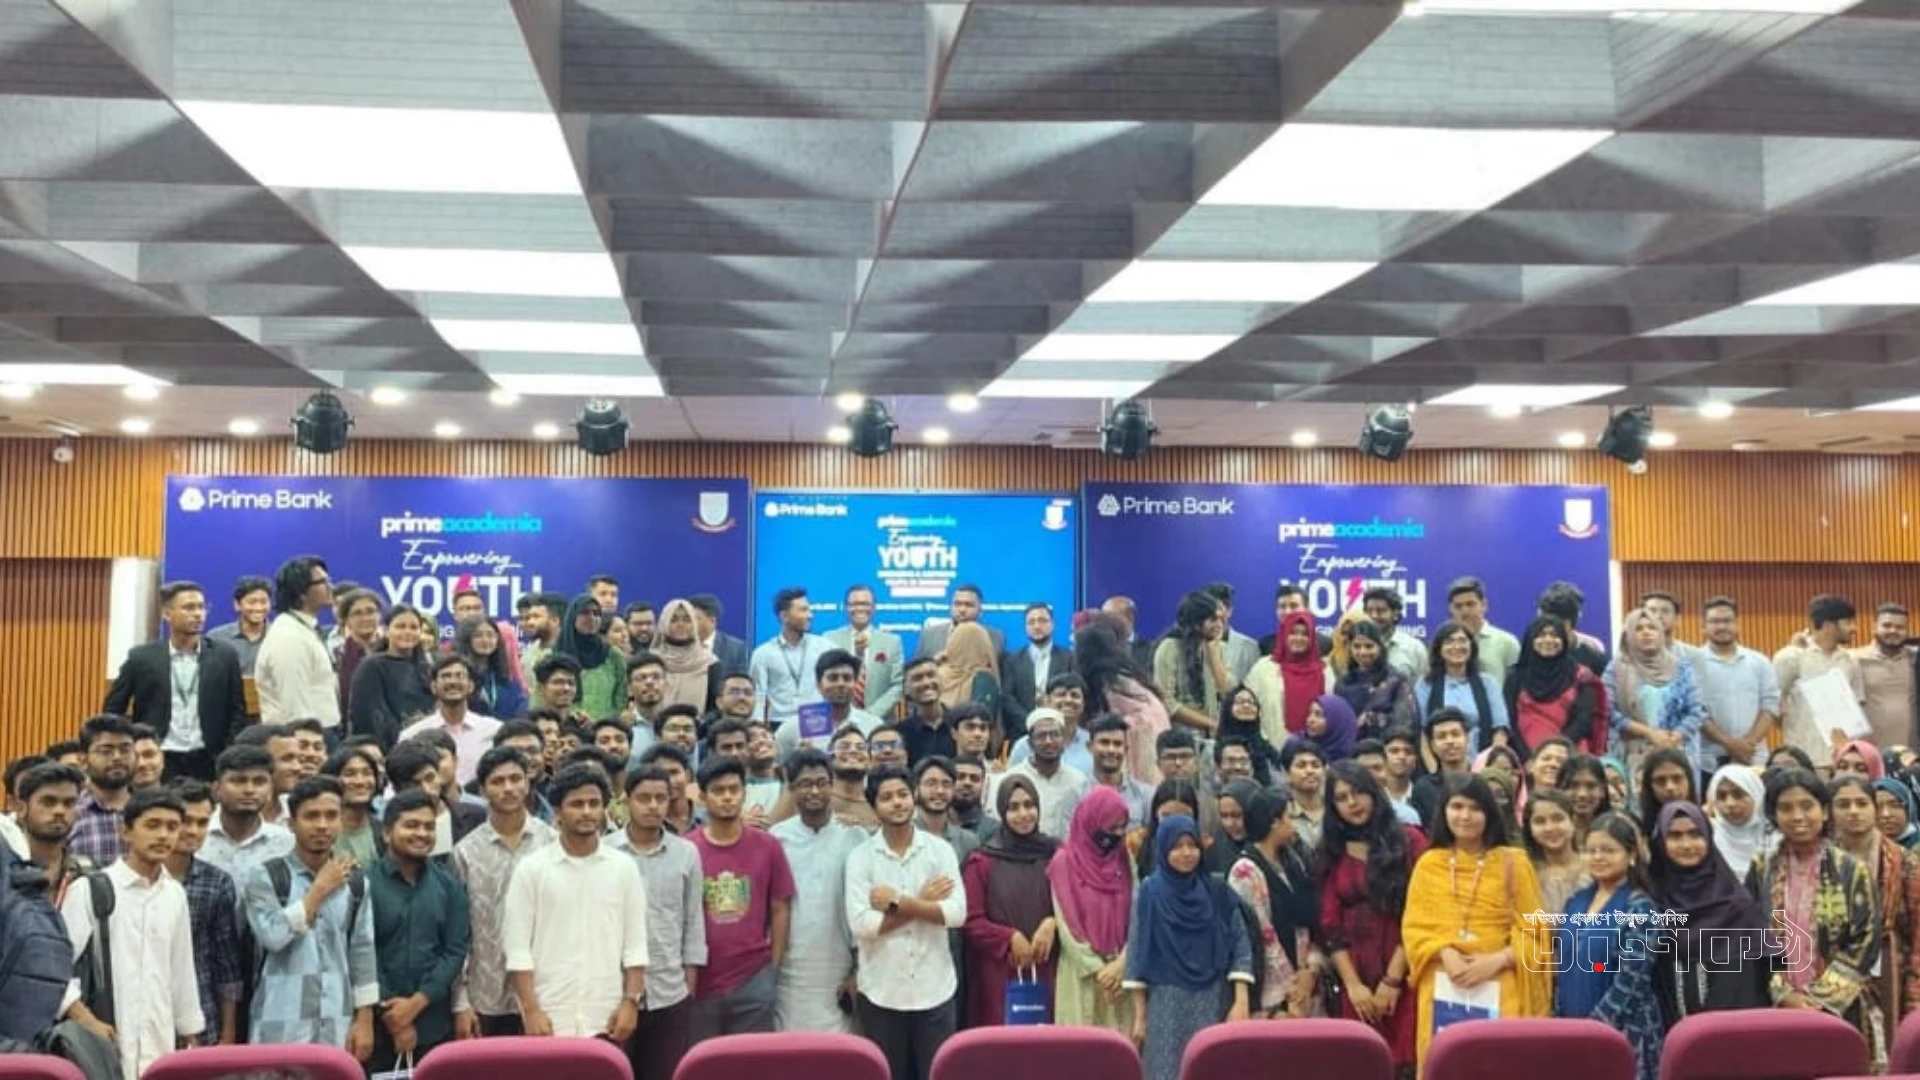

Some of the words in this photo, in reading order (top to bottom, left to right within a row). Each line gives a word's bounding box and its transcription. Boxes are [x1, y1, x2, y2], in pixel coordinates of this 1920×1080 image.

[208, 489, 272, 509] Prime
[275, 489, 332, 509] Bank
[1123, 496, 1181, 514] Prime
[1183, 496, 1234, 514] Bank
[877, 545, 958, 569] YOUTH
